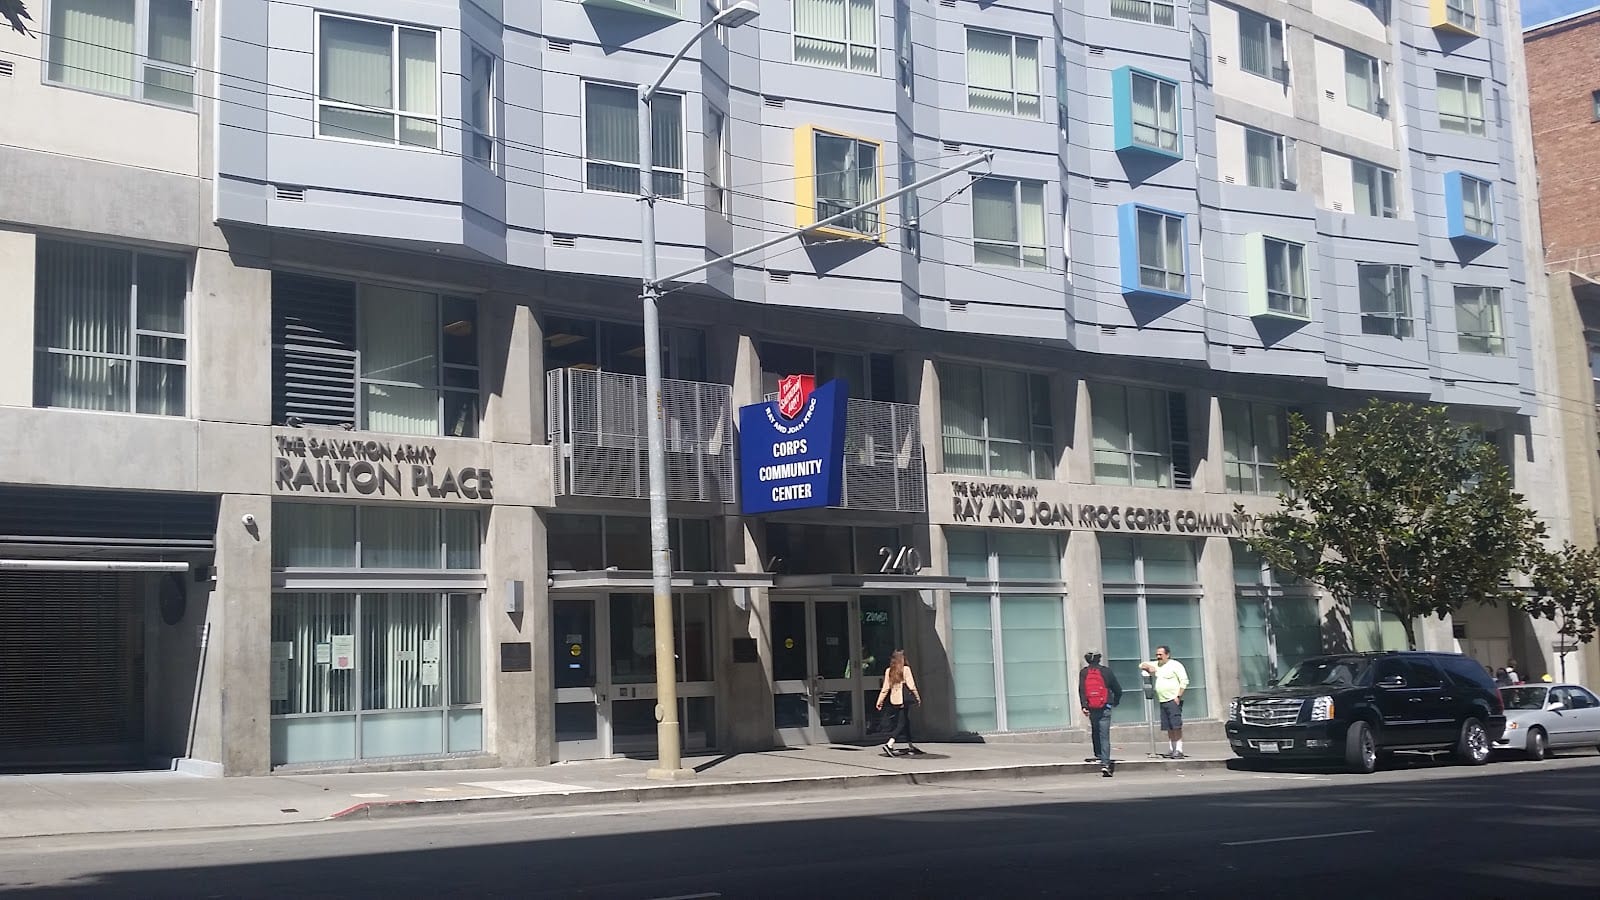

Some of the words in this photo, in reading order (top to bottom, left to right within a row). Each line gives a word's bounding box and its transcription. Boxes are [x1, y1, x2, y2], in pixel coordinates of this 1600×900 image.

[765, 407, 776, 424] RAY
[774, 421, 787, 434] AND
[787, 421, 804, 434] JOAN
[803, 397, 816, 424] KROC
[275, 436, 306, 456] THE
[309, 438, 392, 462] SALVATION
[394, 443, 437, 465] ARMY
[772, 439, 807, 457] CORPS
[275, 457, 402, 497] RAILTON
[411, 465, 493, 499] PLACE
[759, 459, 822, 481] COMMUNITY
[772, 483, 812, 502] CENTER
[952, 497, 983, 522] RAY
[987, 499, 1025, 524] AND
[1029, 501, 1073, 526] JOAN
[1078, 505, 1120, 529] KROC
[1125, 507, 1171, 531] CORPS
[879, 546, 920, 574] 240
